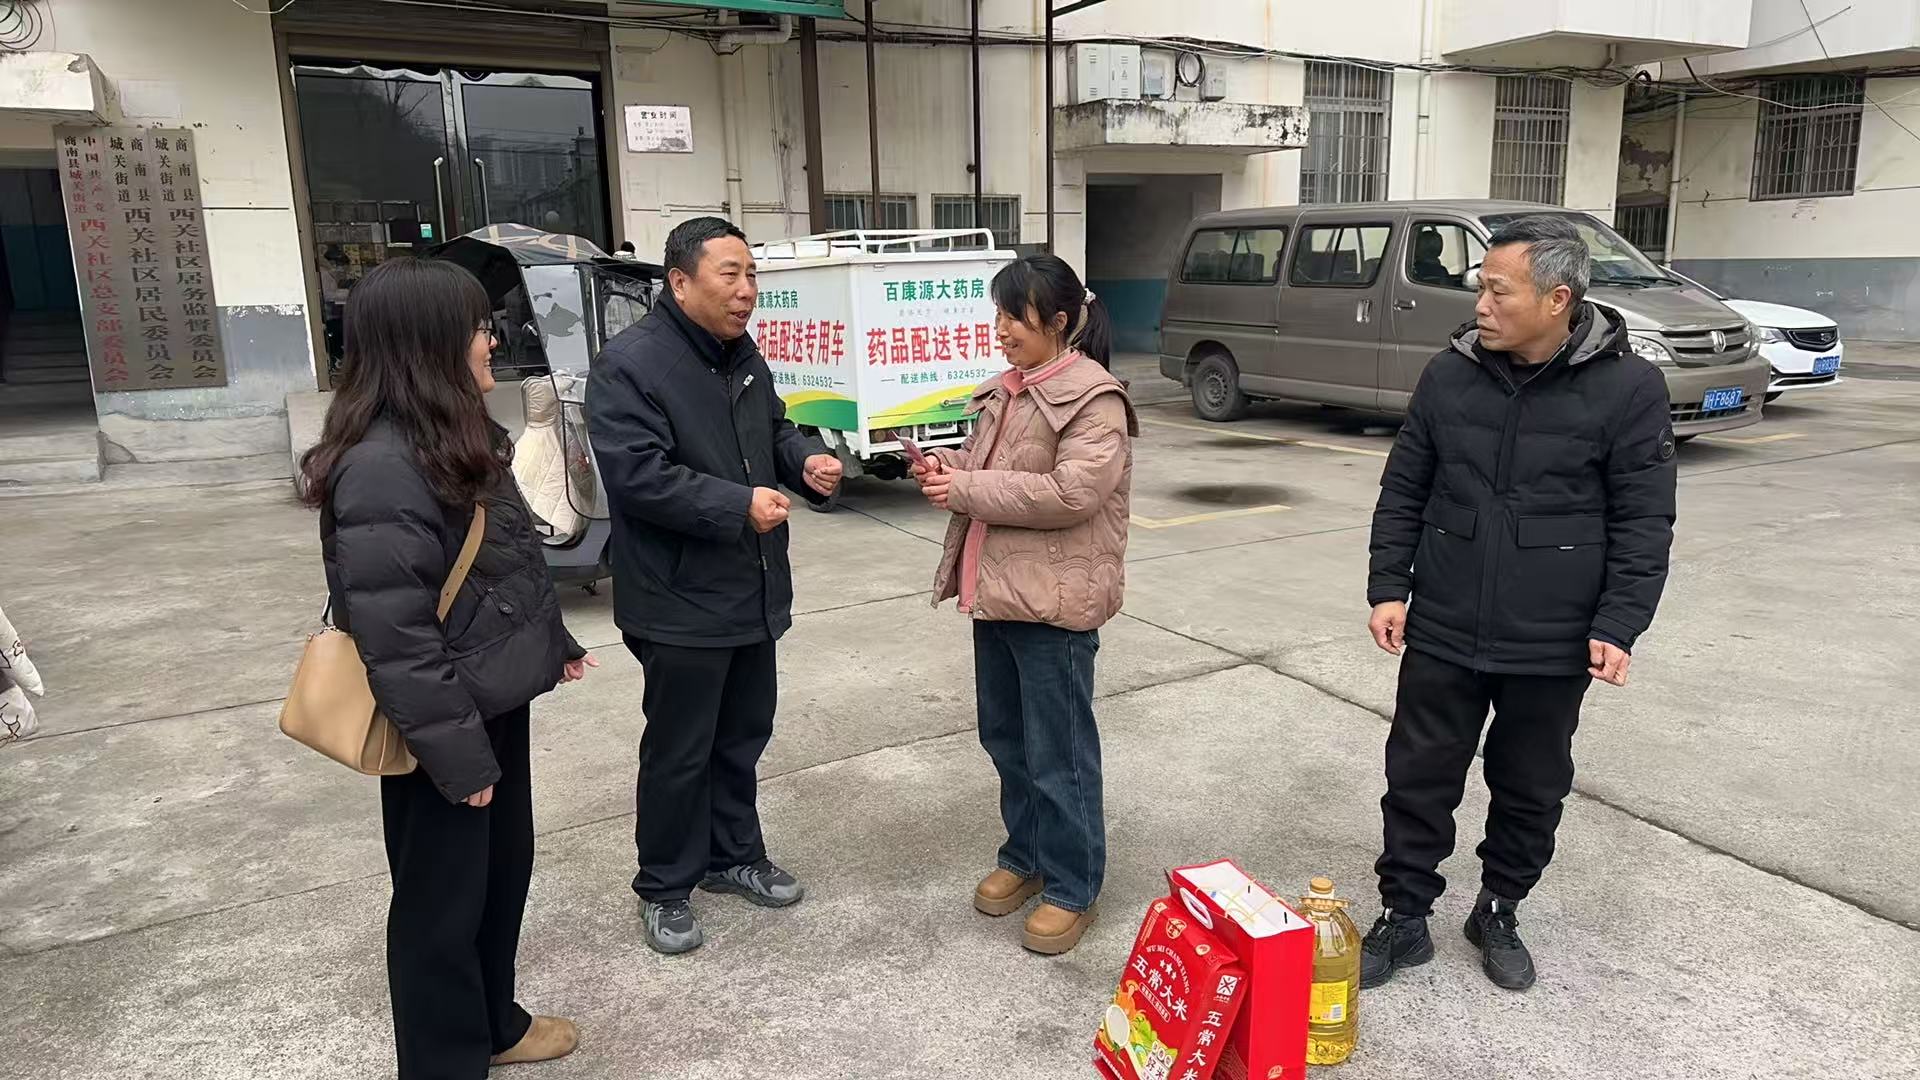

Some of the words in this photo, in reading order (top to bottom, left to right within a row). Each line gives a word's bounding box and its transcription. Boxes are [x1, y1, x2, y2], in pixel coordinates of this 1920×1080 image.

[110, 136, 130, 203] 城关街道
[130, 138, 151, 202] 商南县
[155, 137, 176, 203] 城关街道
[175, 137, 195, 202] 商南县
[125, 208, 175, 380] 西关社区居民委员会
[755, 290, 798, 309] 康源大药房
[883, 279, 984, 301] 百康源大药房
[757, 318, 845, 366] 药品配送专用车
[1132, 954, 1188, 1021] 五常大米
[1180, 1010, 1223, 1080] 五常大米
